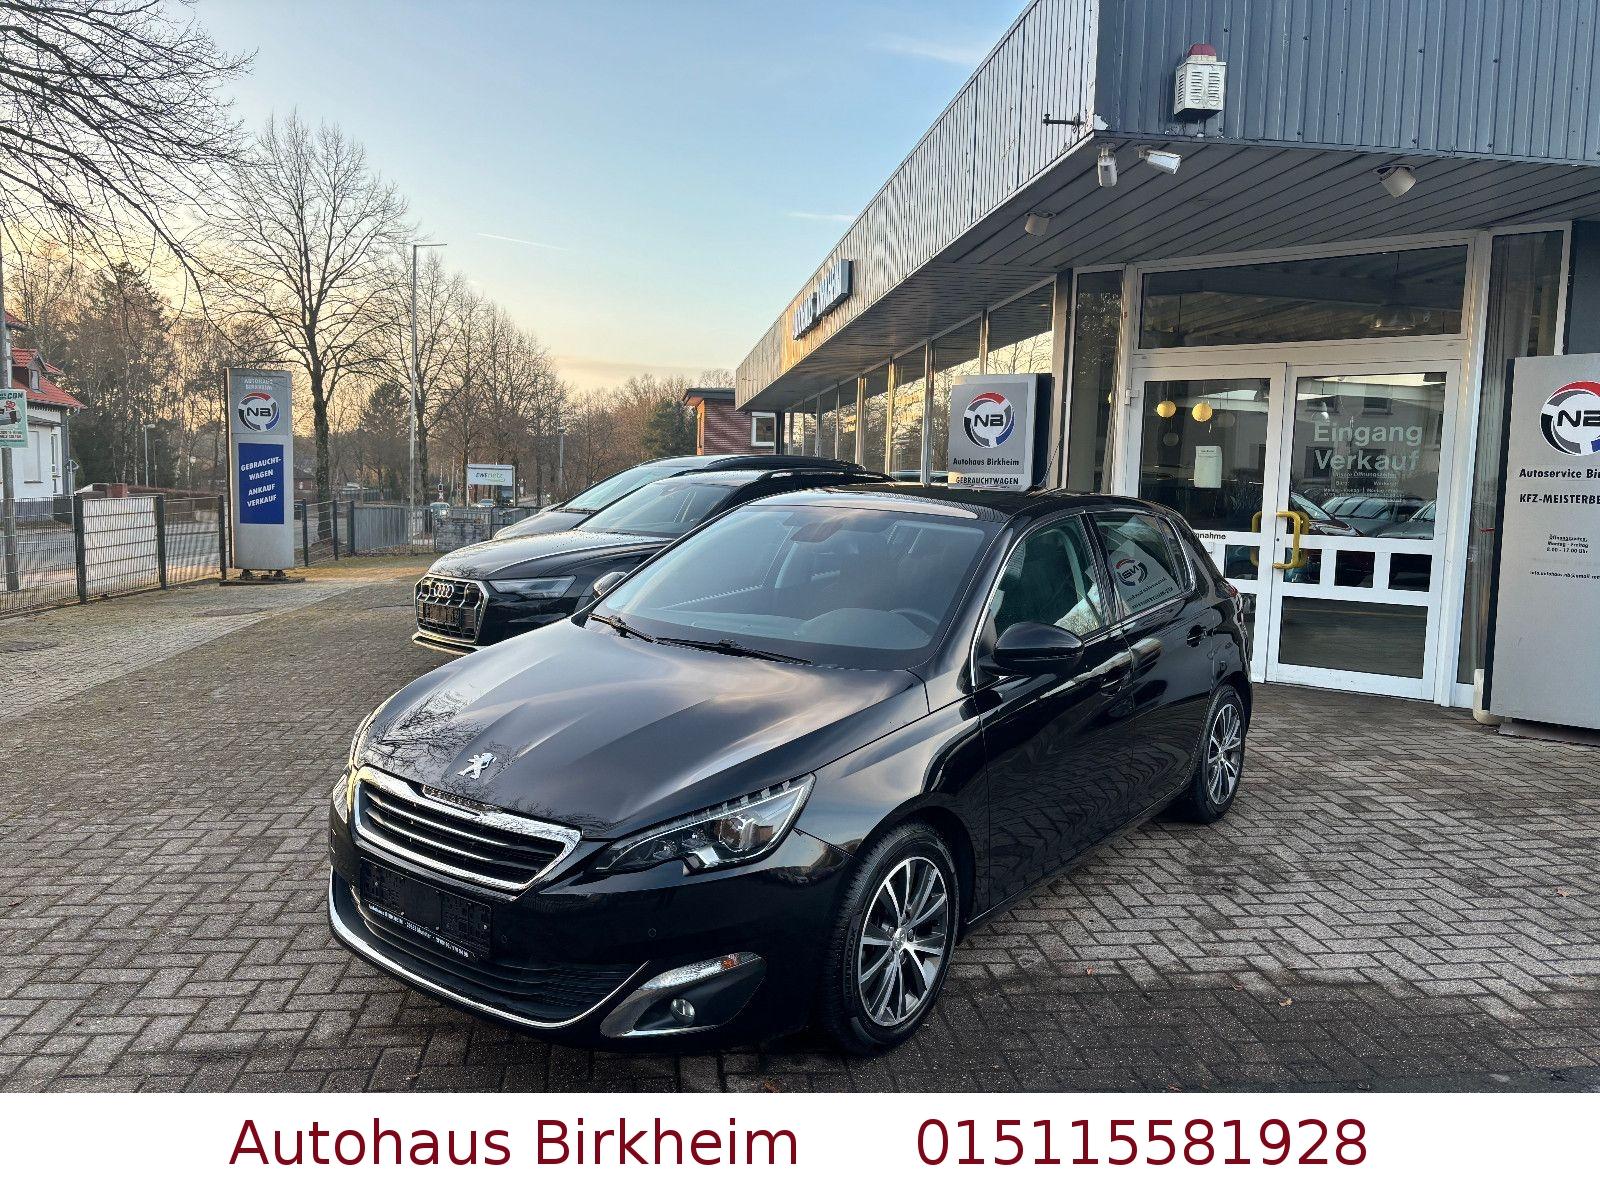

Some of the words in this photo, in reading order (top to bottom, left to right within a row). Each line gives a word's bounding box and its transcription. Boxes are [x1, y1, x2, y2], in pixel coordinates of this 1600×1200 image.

[246, 406, 272, 417] NB
[1556, 409, 1600, 428] NB
[974, 413, 1004, 428] NB
[1313, 421, 1423, 447] Eingang
[240, 456, 282, 472] GEBRAUCHT-
[952, 457, 985, 466] Autohaus
[986, 457, 1020, 466] Birkheim
[1314, 448, 1420, 471] Verkauf
[248, 469, 274, 481] WAGEN
[955, 476, 1020, 485] GEBRAUCHTWAGEN
[1519, 468, 1582, 479] Autoservice
[248, 483, 276, 496] ANKAUF
[246, 493, 277, 508] VERKAUF
